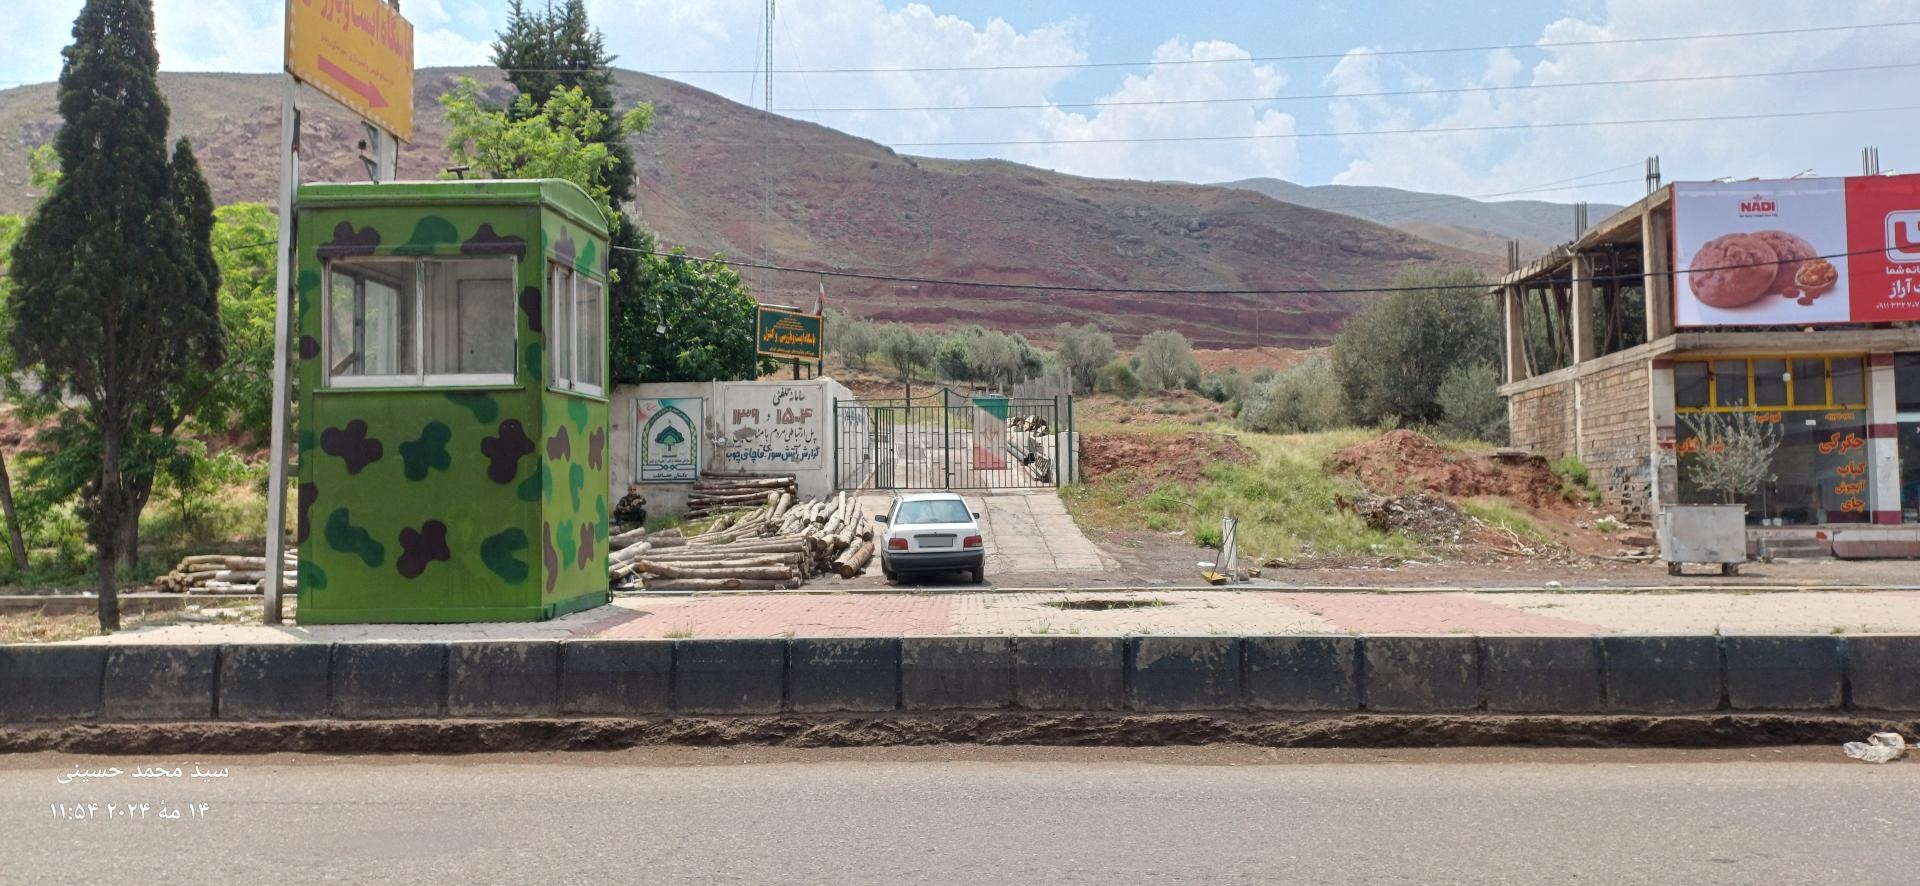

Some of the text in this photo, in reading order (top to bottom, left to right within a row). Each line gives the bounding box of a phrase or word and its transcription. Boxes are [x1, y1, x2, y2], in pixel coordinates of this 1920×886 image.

[1740, 201, 1776, 213] NADI
[1886, 264, 1905, 275] شما
[1888, 278, 1912, 299] آراز
[776, 407, 813, 424] ۱۵۰۴
[1841, 497, 1864, 512] چای
